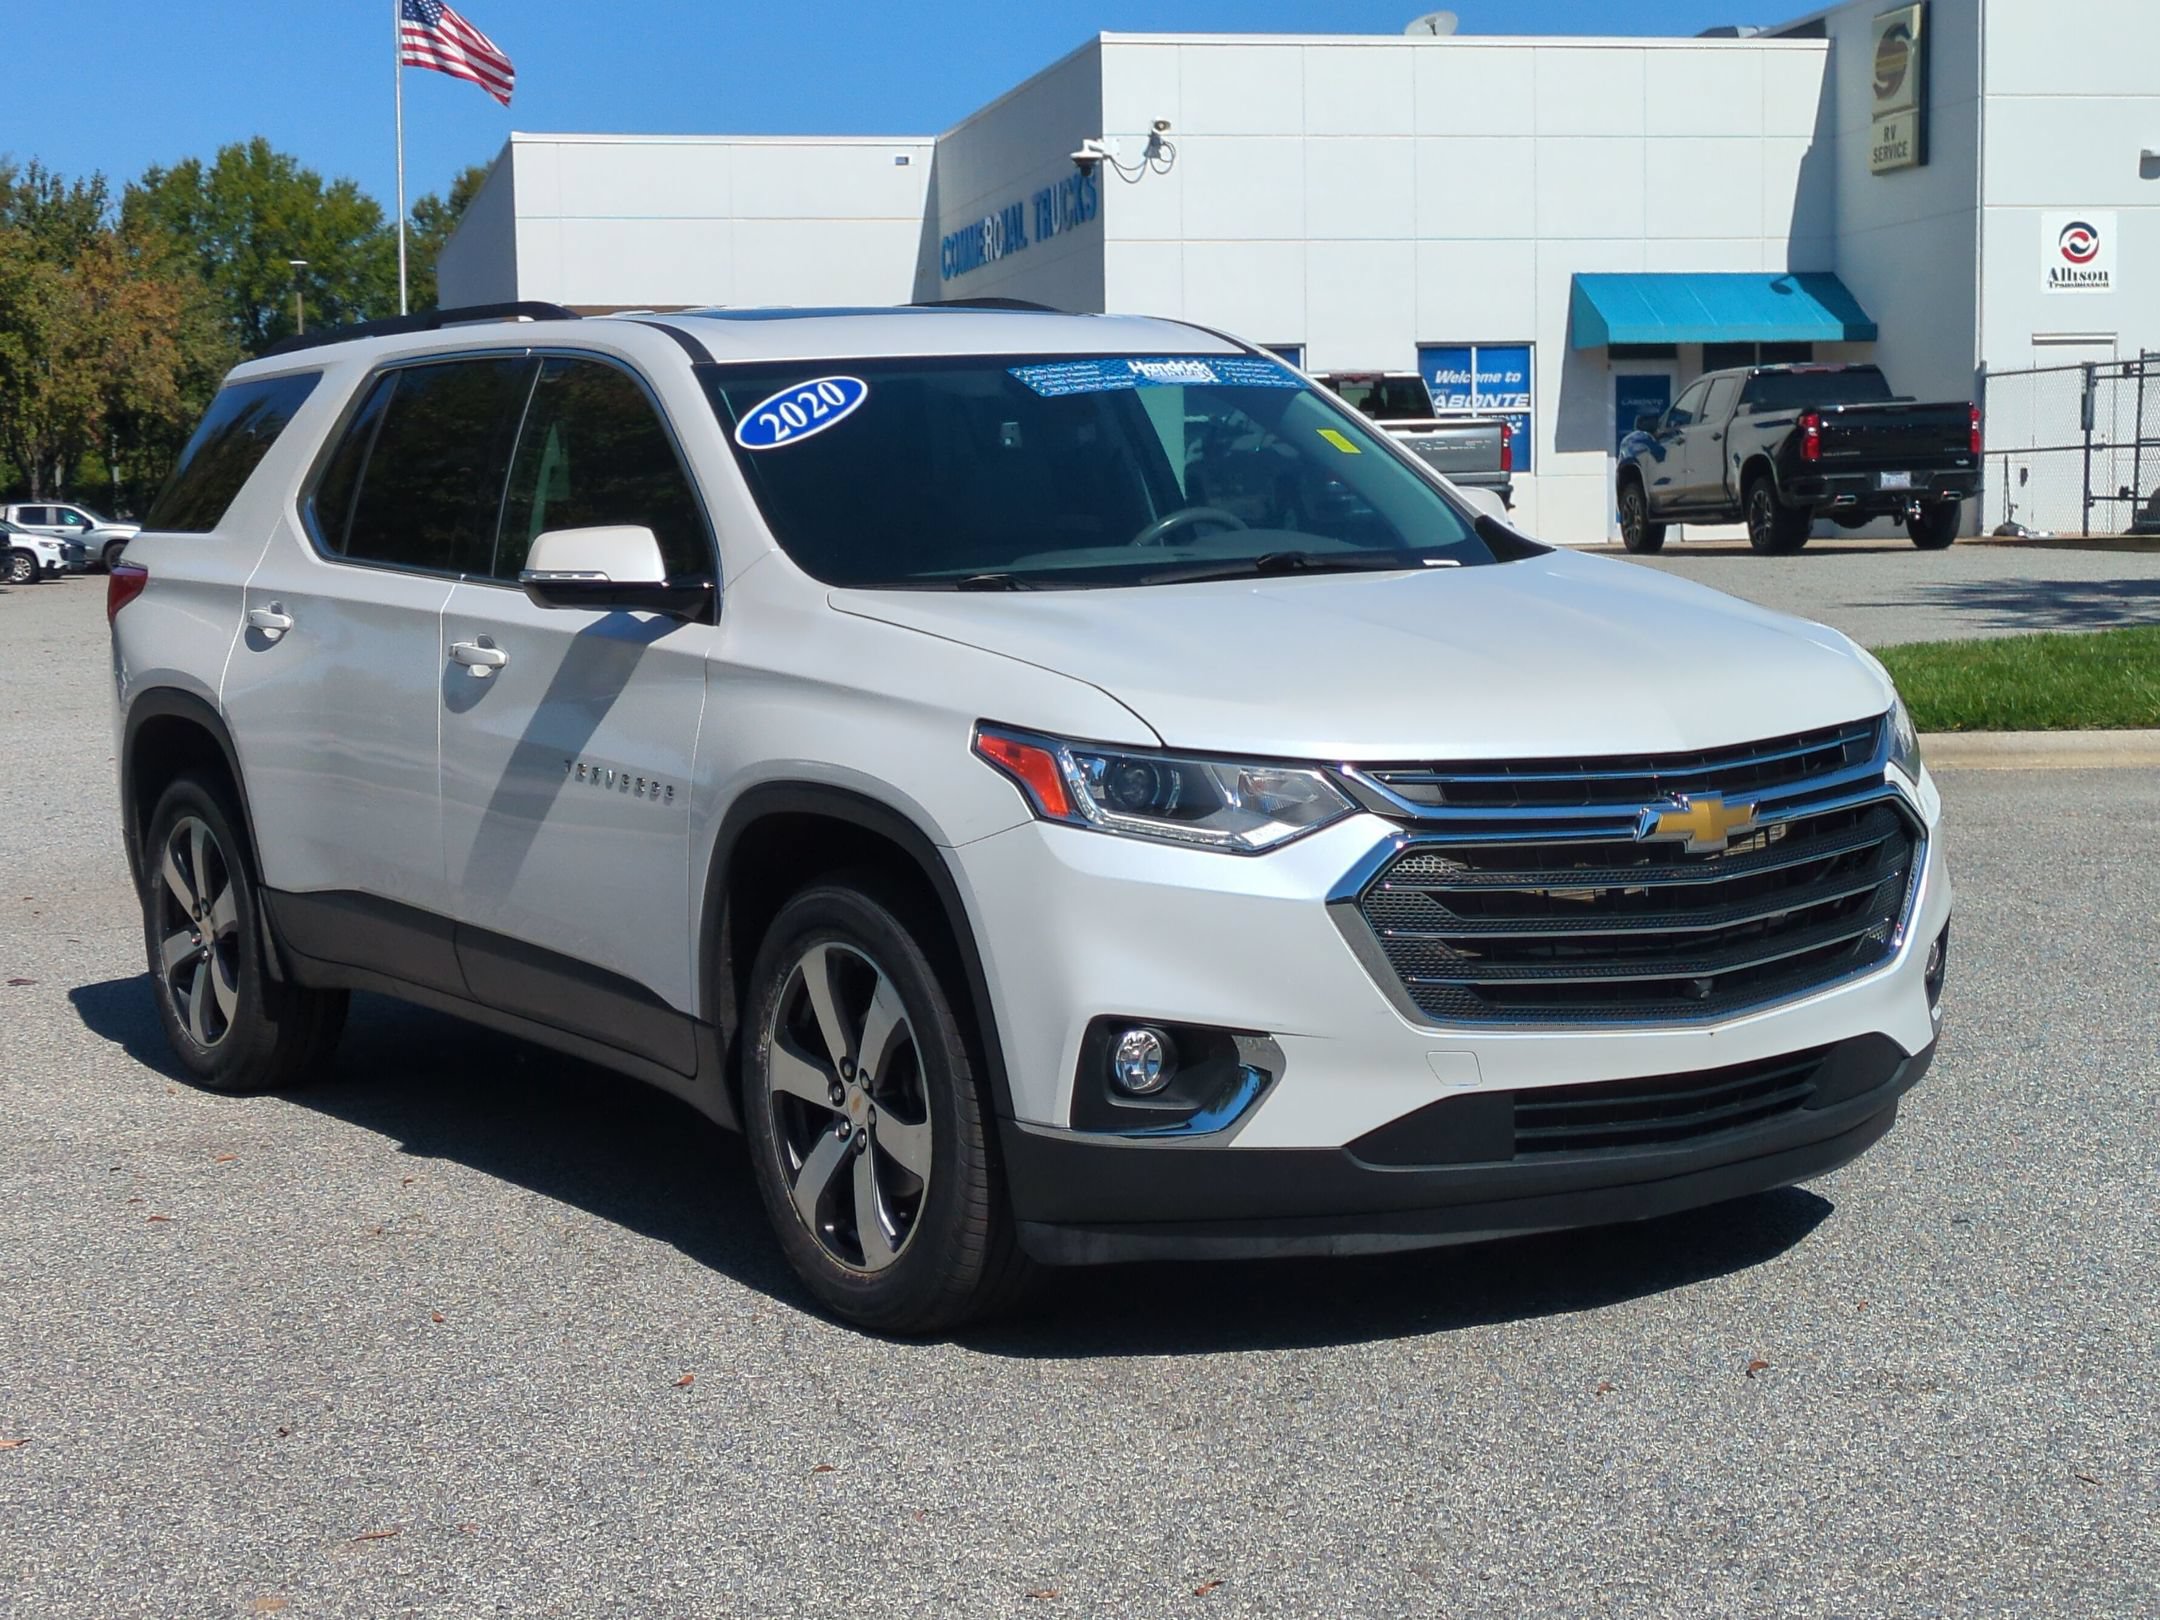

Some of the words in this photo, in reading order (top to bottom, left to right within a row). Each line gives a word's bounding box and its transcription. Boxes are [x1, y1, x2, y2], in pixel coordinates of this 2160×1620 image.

[1883, 124, 1897, 142] RV
[1872, 141, 1908, 164] SERVICE
[941, 201, 1028, 281] COMMERCIAL
[1032, 171, 1098, 243] TRUCKS
[2047, 267, 2109, 281] Allison
[1504, 371, 1522, 383] to
[1433, 393, 1530, 408] ABONTE
[758, 381, 846, 442] 2020
